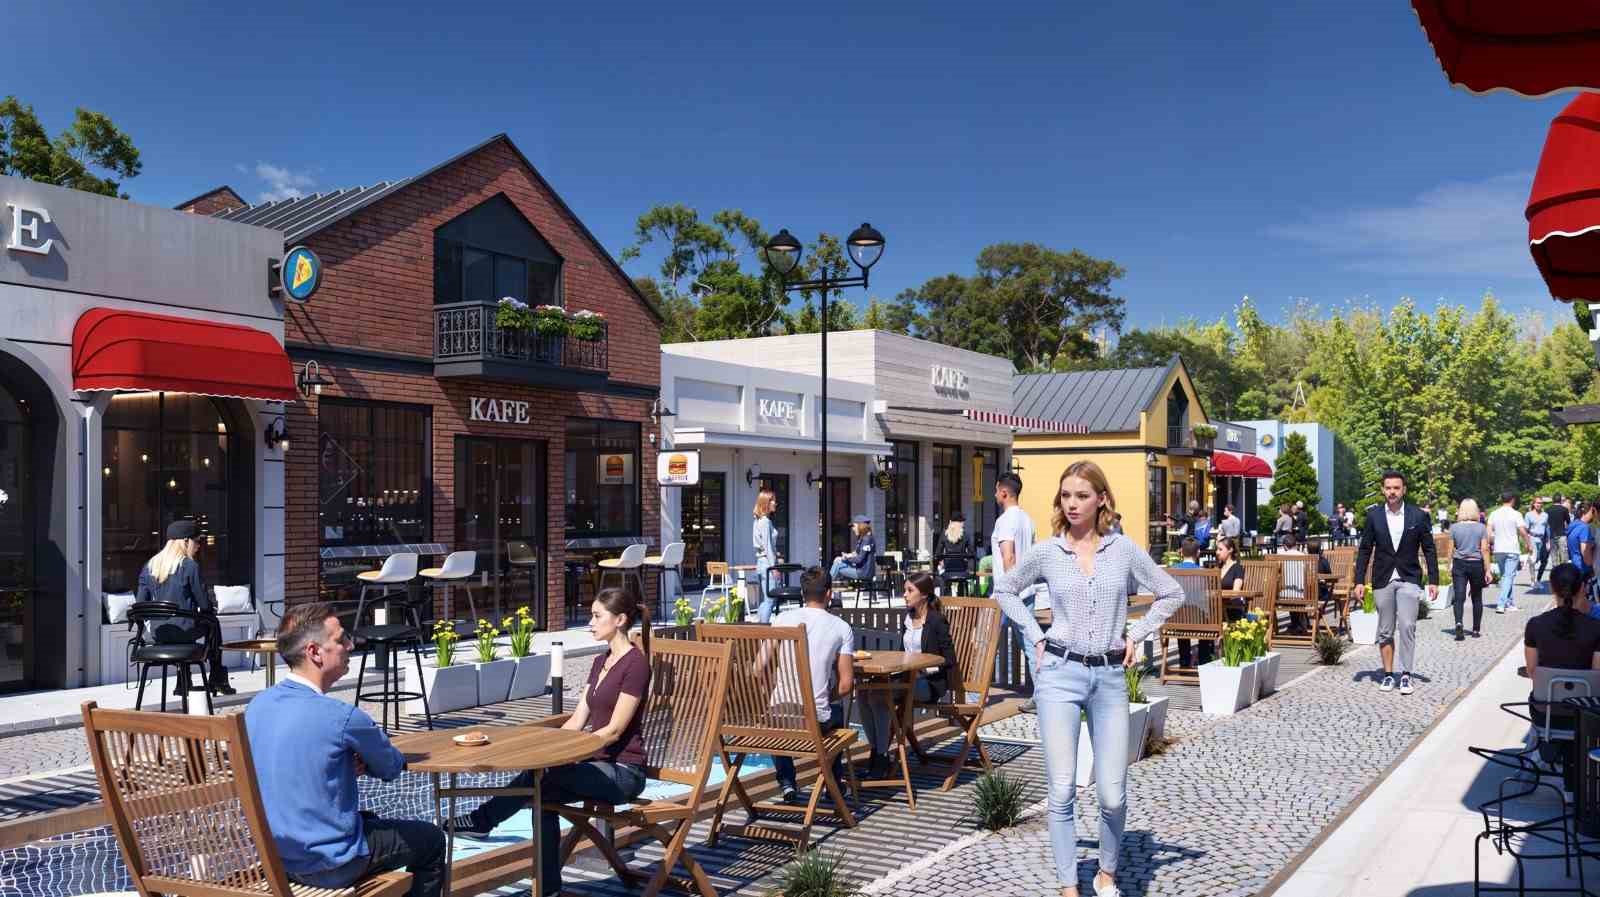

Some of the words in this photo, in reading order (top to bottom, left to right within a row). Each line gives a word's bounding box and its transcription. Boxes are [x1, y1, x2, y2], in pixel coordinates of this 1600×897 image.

[6, 201, 53, 255] E
[930, 365, 968, 389] KAFE
[469, 397, 530, 423] KAFE
[760, 398, 794, 419] KAFE
